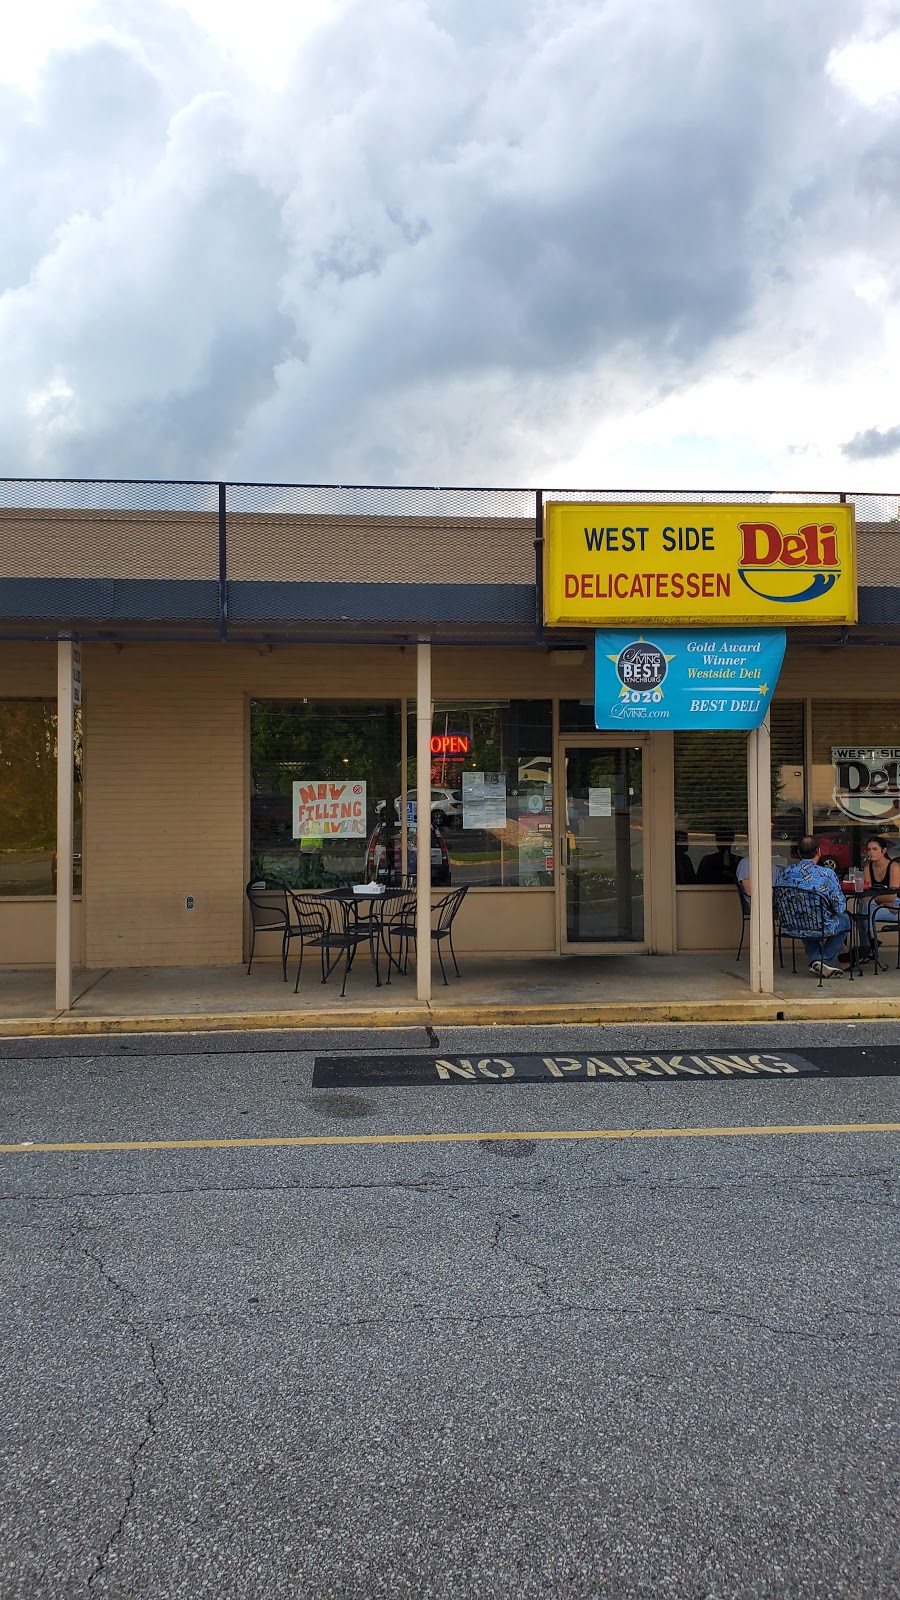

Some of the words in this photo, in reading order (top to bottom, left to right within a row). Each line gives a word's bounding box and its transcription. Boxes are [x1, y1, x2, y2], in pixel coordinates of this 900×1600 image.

[584, 527, 649, 551] WEST
[662, 527, 715, 551] SIDE
[738, 523, 841, 567] Deli
[565, 573, 731, 598] DELICATESSEN
[686, 642, 716, 653] Gold
[718, 642, 762, 653] Award
[702, 655, 747, 666] Winner
[623, 664, 661, 678] BEST
[687, 667, 736, 679] Westside
[738, 668, 762, 679] Deli
[620, 691, 663, 704] 2020
[689, 699, 728, 713] BEST
[729, 700, 761, 713] DELI
[430, 735, 468, 753] OPEN
[837, 749, 875, 758] WEST
[299, 783, 347, 805] NOW
[298, 800, 363, 822] FILLING
[434, 1058, 516, 1079] NO
[541, 1054, 800, 1077] PARKING
